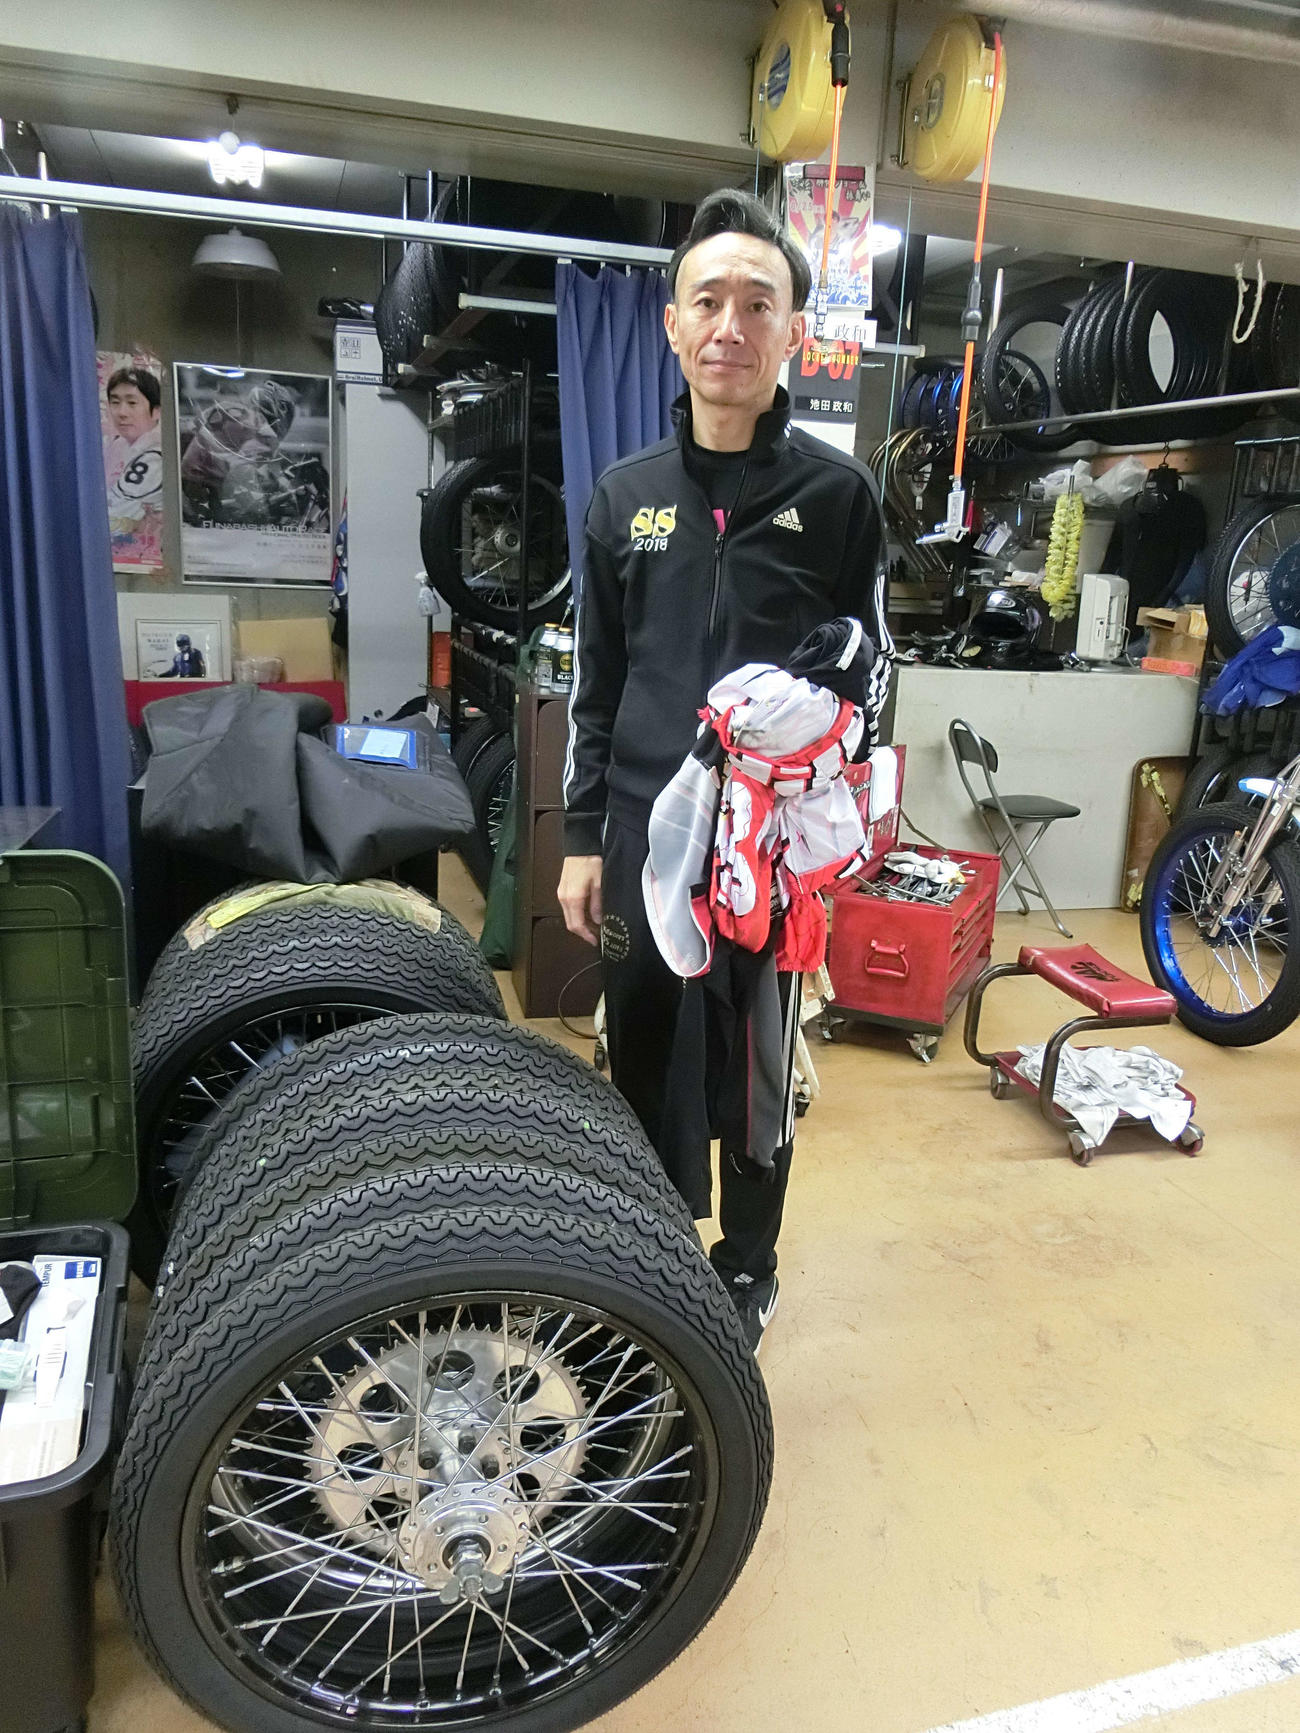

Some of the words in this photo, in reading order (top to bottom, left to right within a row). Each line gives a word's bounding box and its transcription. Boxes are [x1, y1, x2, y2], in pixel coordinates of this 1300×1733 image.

[803, 351, 829, 363] LOCKE
[832, 353, 859, 365] NUMBER
[810, 398, 853, 413] 池田政和
[124, 461, 149, 485] 8
[772, 517, 803, 533] adidas
[633, 537, 668, 551] 2018
